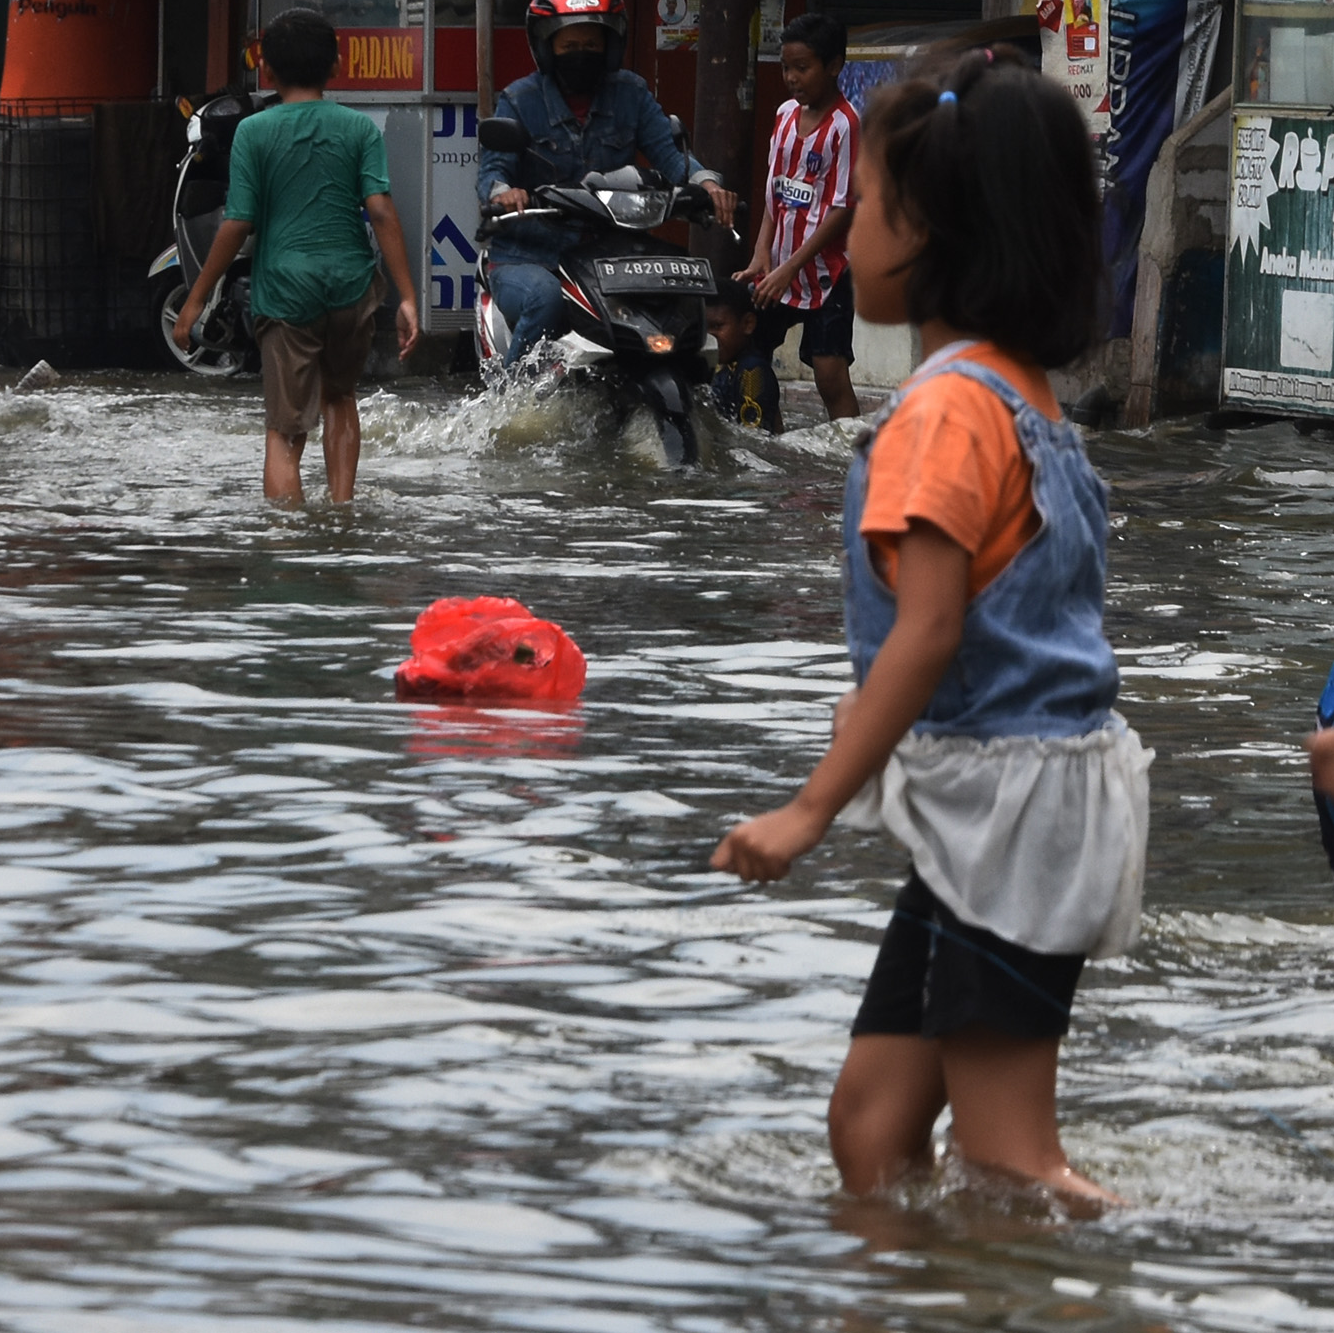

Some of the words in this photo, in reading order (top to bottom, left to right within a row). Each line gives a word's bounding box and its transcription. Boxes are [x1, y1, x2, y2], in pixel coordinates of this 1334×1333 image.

[348, 36, 415, 79] PADANG
[604, 263, 615, 275] B
[624, 262, 664, 275] 4820
[670, 262, 702, 276] BBX
[1260, 246, 1297, 277] Aneka
